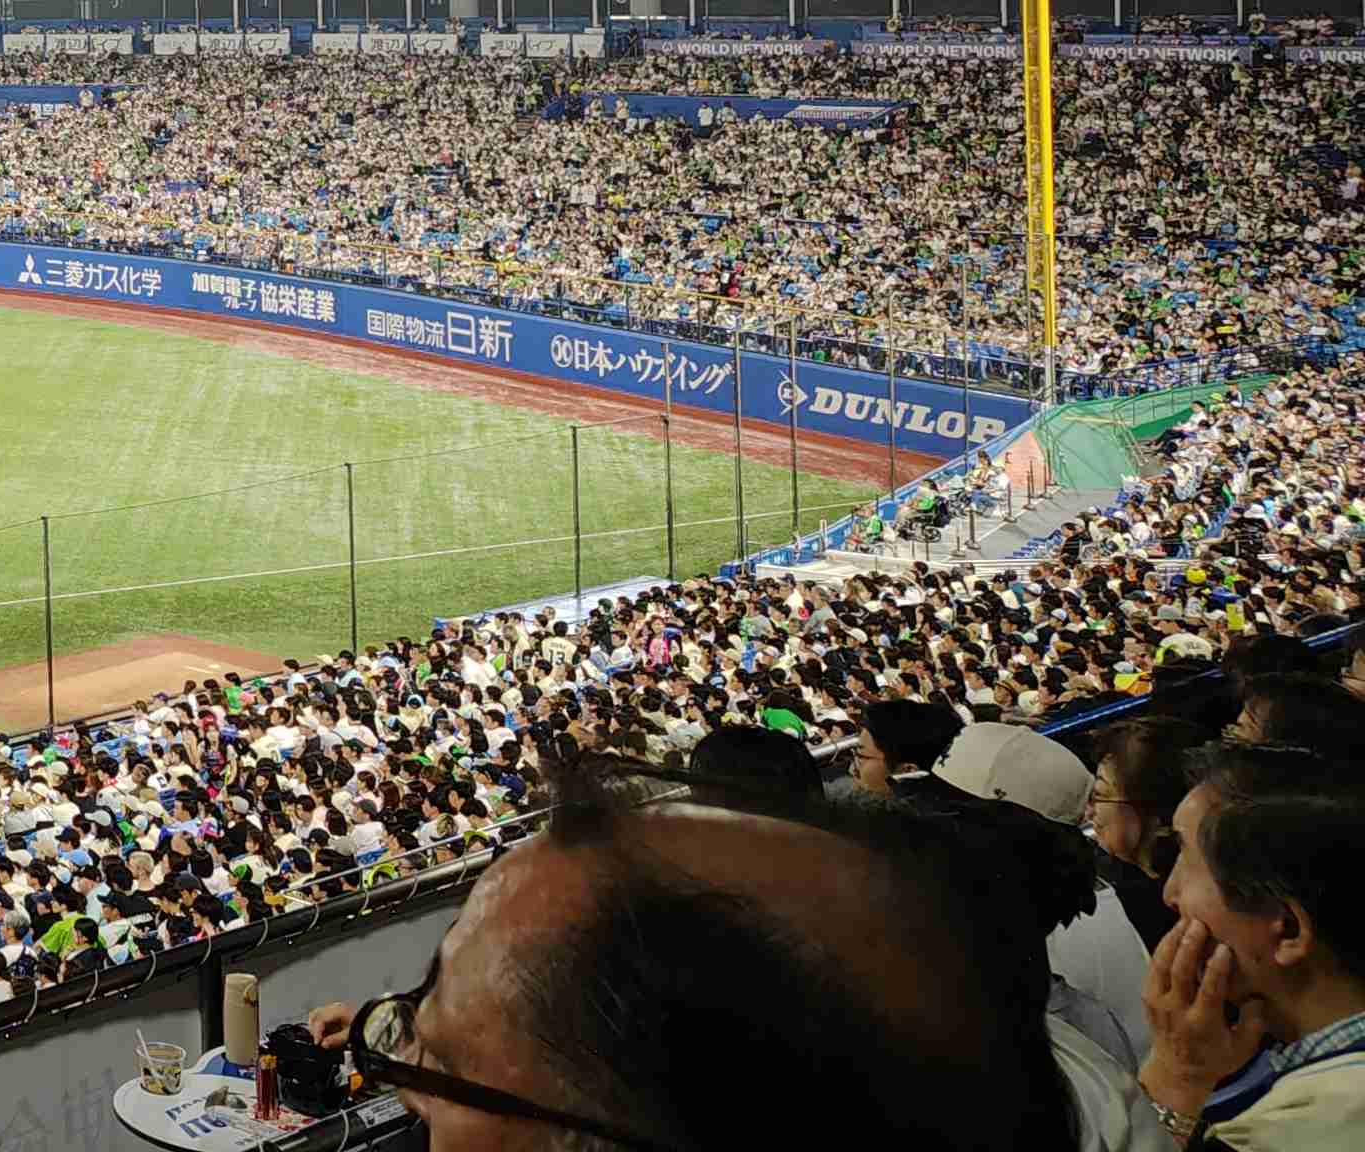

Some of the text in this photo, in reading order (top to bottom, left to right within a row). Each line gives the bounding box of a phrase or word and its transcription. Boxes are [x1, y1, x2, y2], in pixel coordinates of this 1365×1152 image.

[677, 41, 804, 55] WORLD NETWORK
[45, 259, 162, 297] 三菱ガス化学
[192, 272, 257, 298] 加賀電子
[260, 281, 335, 322] 協栄産業
[367, 309, 514, 362] 国際物流 日新
[573, 339, 735, 395] 日本ハウズイング
[810, 385, 1007, 443] DUNLOP
